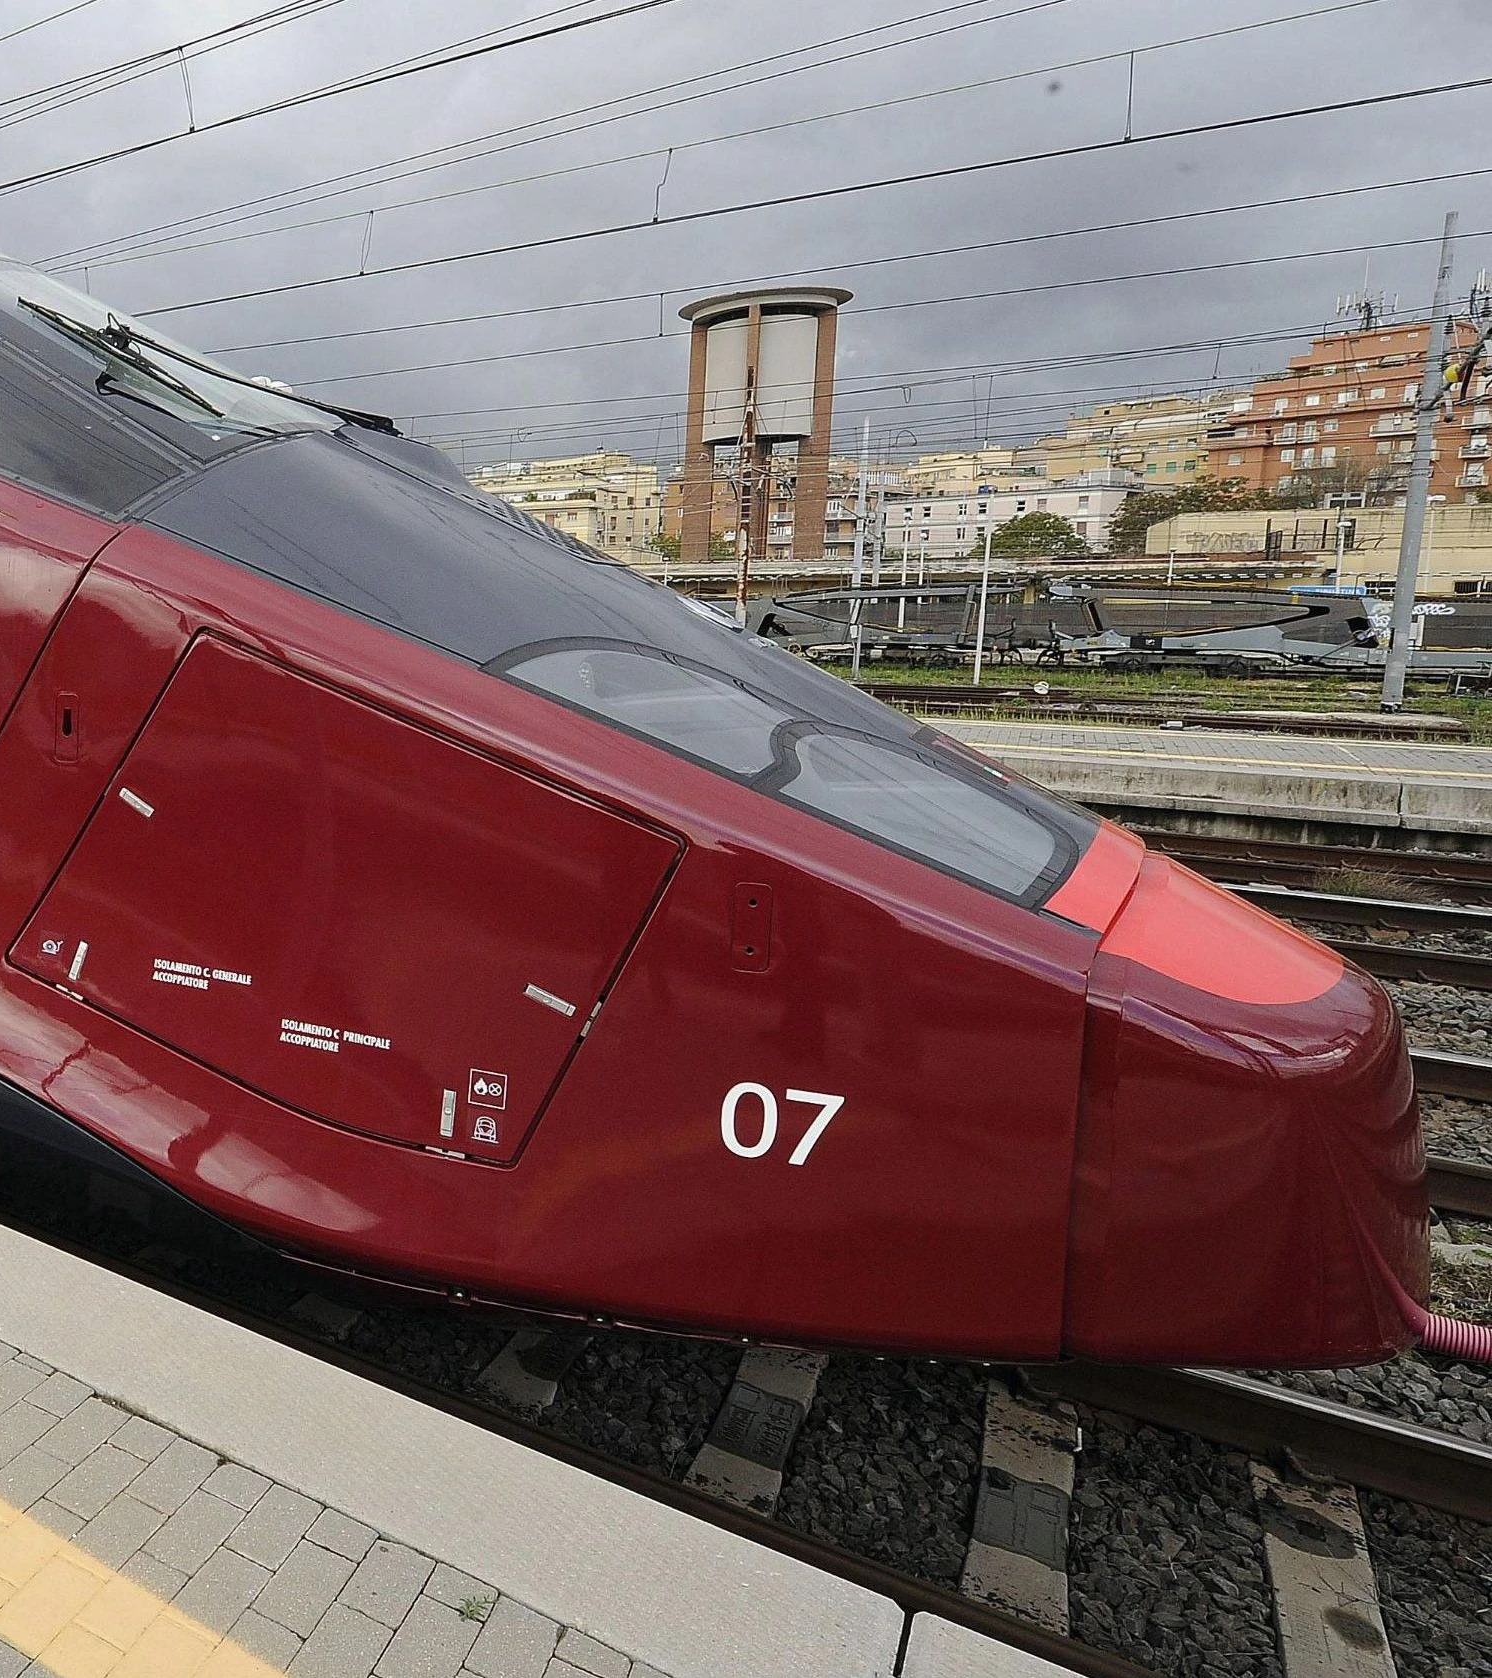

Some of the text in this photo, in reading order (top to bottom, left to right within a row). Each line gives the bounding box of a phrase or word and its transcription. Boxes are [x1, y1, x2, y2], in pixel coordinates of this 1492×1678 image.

[152, 971, 208, 990] ACCOPPIATORE
[153, 959, 202, 976] ISOLAMENTO
[212, 969, 252, 985] GENERALE
[280, 1032, 339, 1052] ACCOPPIATORE
[281, 1019, 332, 1038] ISOLAMENTO
[343, 1031, 390, 1049] PRINCIPALE
[721, 1082, 845, 1166] 07
